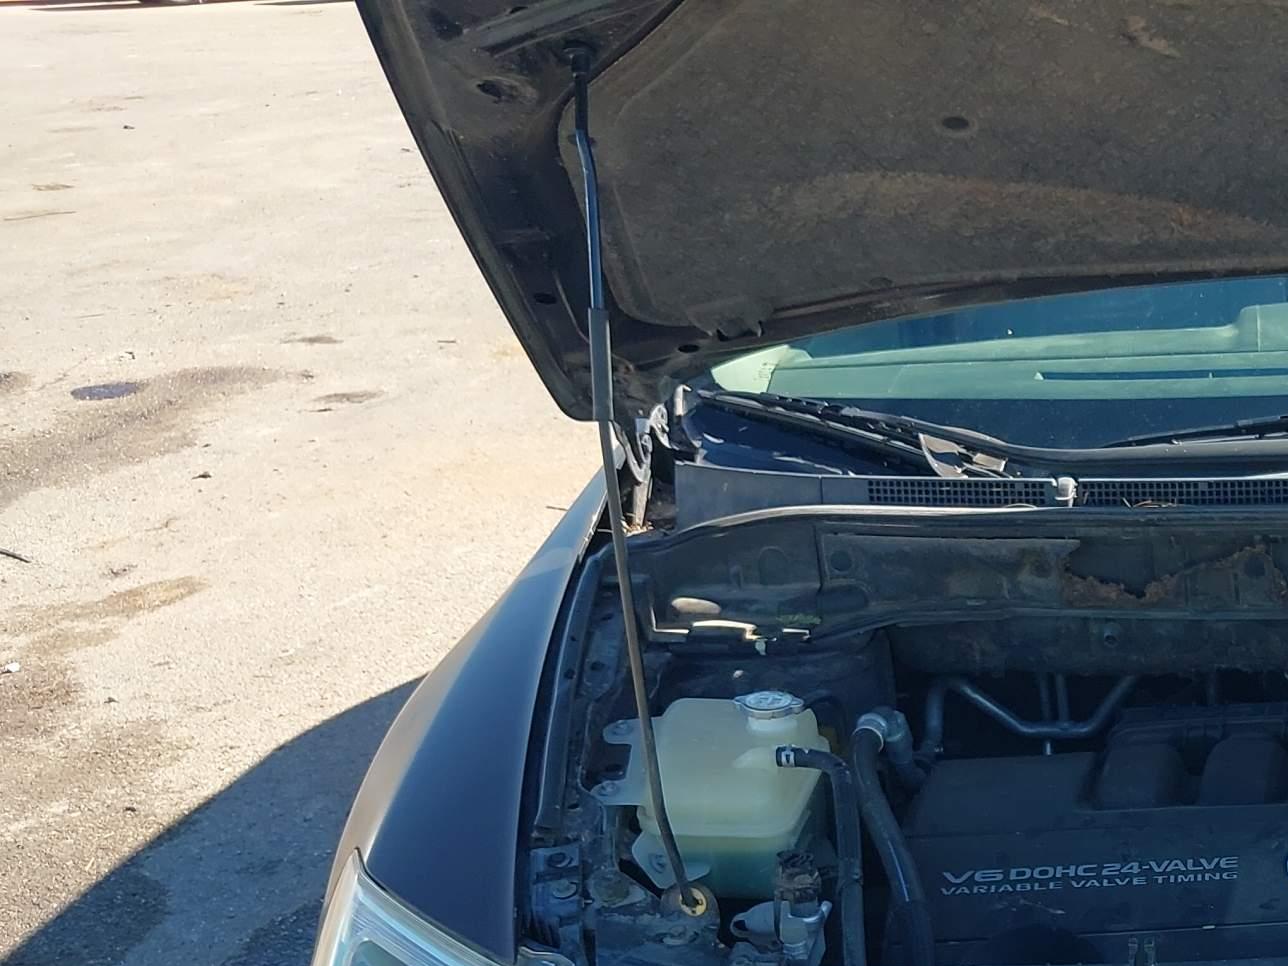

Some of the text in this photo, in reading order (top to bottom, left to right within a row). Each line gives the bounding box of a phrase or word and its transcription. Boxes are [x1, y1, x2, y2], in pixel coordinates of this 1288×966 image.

[942, 855, 1240, 884] V6 DOHC 24-VALVE
[940, 871, 1239, 896] VARIABLE VALVE TIMING
